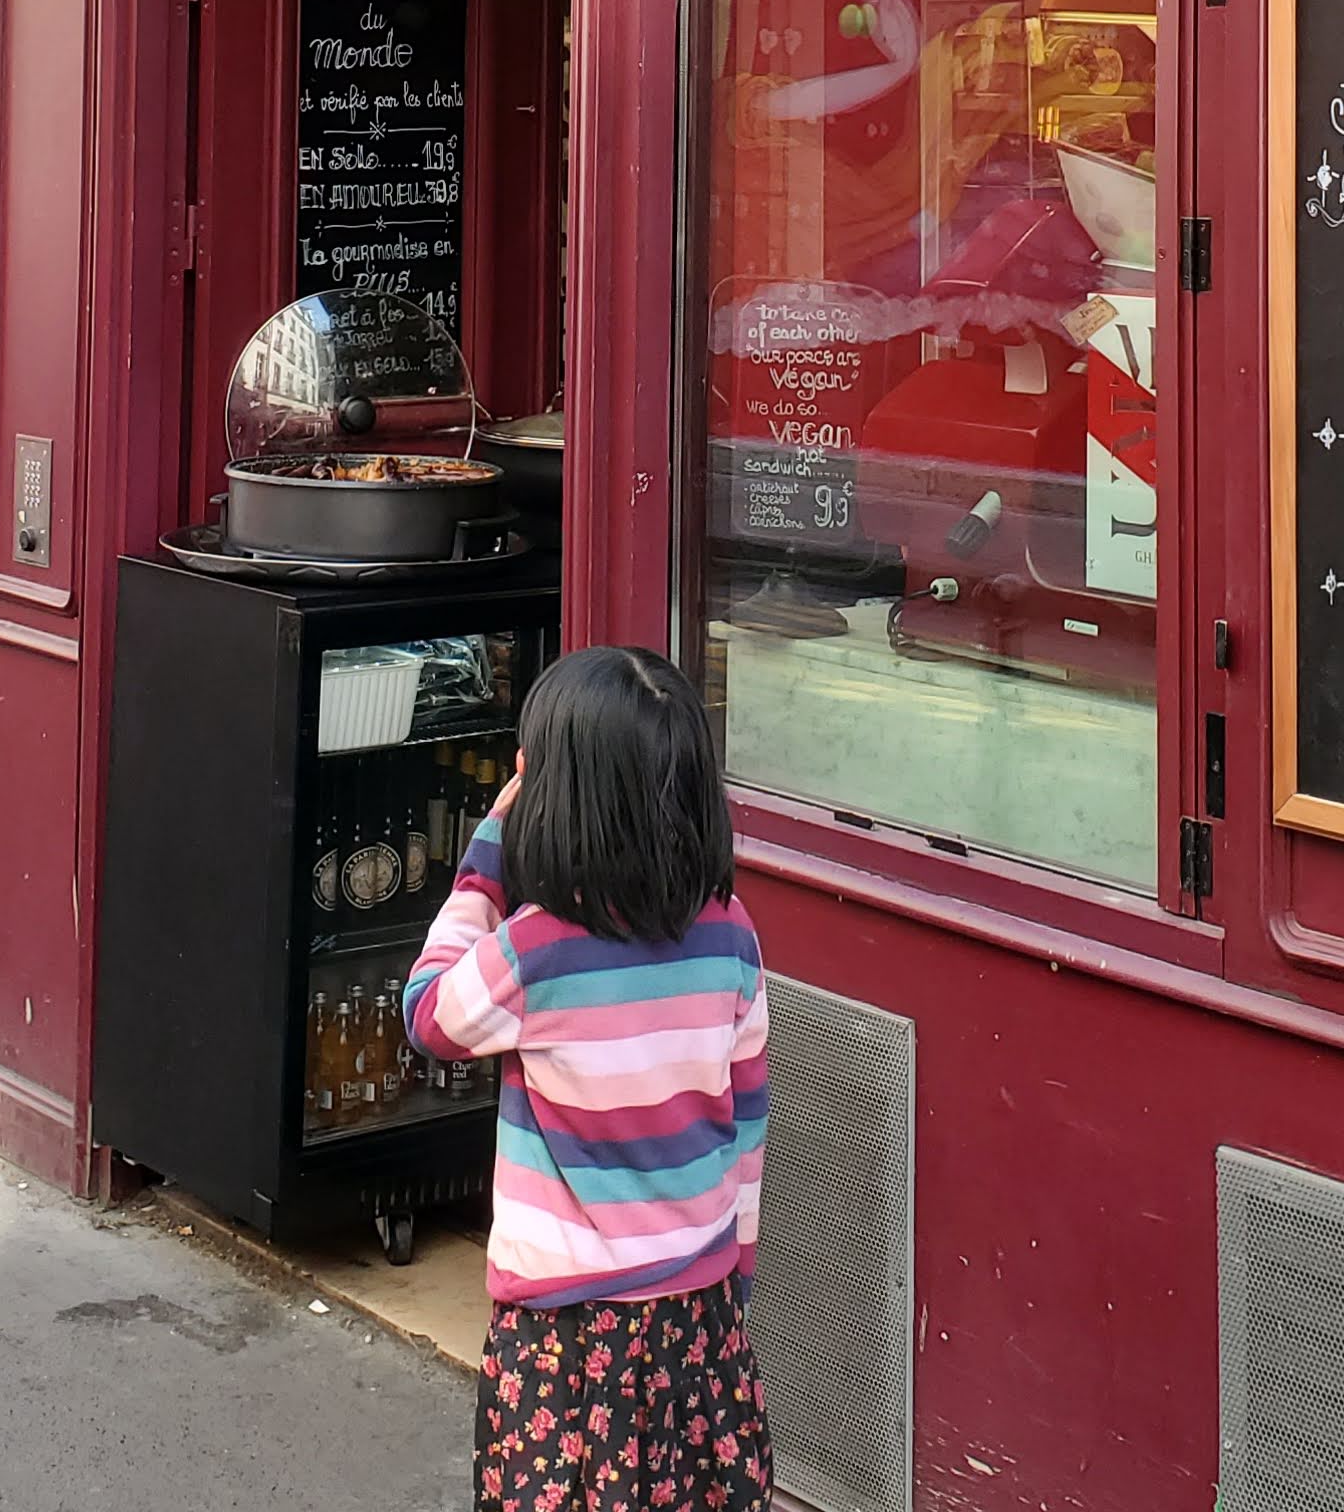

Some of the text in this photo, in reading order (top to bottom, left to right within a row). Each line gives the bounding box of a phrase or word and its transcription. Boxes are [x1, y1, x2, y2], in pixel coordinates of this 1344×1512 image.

[359, 2, 388, 30] du
[309, 27, 414, 69] Monde
[300, 89, 314, 112] et
[403, 80, 421, 108] les
[426, 80, 464, 108] clients
[299, 147, 325, 171] EN
[300, 184, 326, 210] EN
[433, 240, 455, 256] en
[769, 323, 813, 341] each
[773, 398, 795, 416] do
